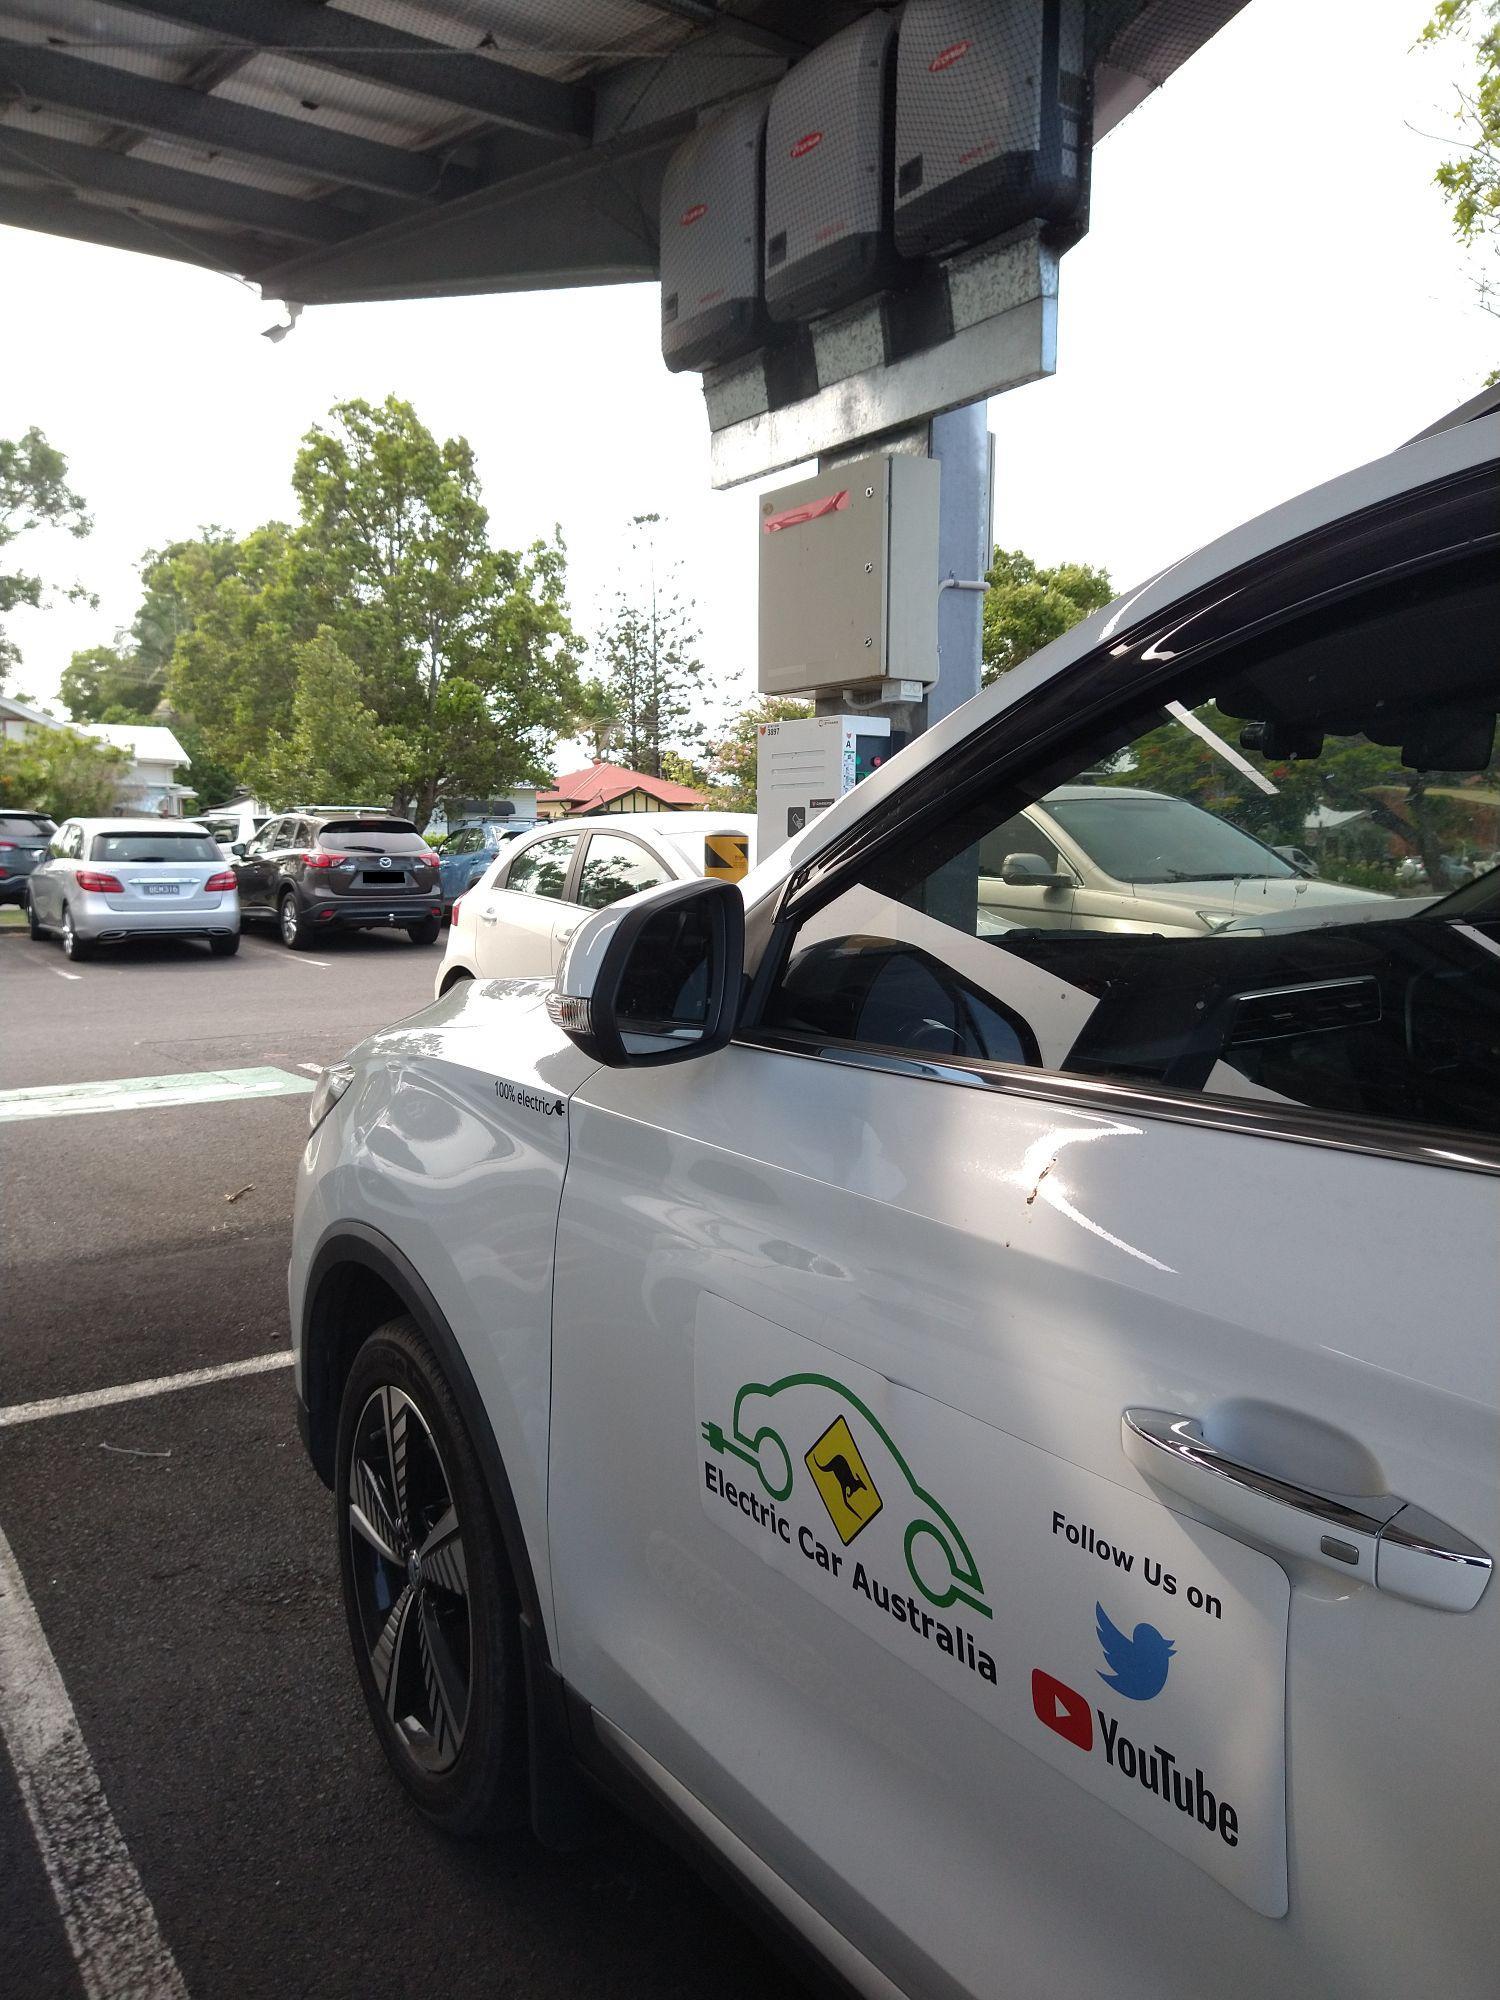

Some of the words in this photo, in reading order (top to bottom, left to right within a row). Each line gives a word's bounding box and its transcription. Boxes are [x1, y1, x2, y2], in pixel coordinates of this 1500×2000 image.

[495, 1081, 515, 1102] 100%
[517, 1089, 553, 1115] electric
[705, 1461, 790, 1544] Electric
[798, 1525, 842, 1577] Car
[852, 1562, 997, 1686] Australia
[1052, 1510, 1135, 1573] Follow
[1143, 1557, 1177, 1595] Us
[1187, 1586, 1222, 1620] on
[1097, 1709, 1239, 1847] YouTube
